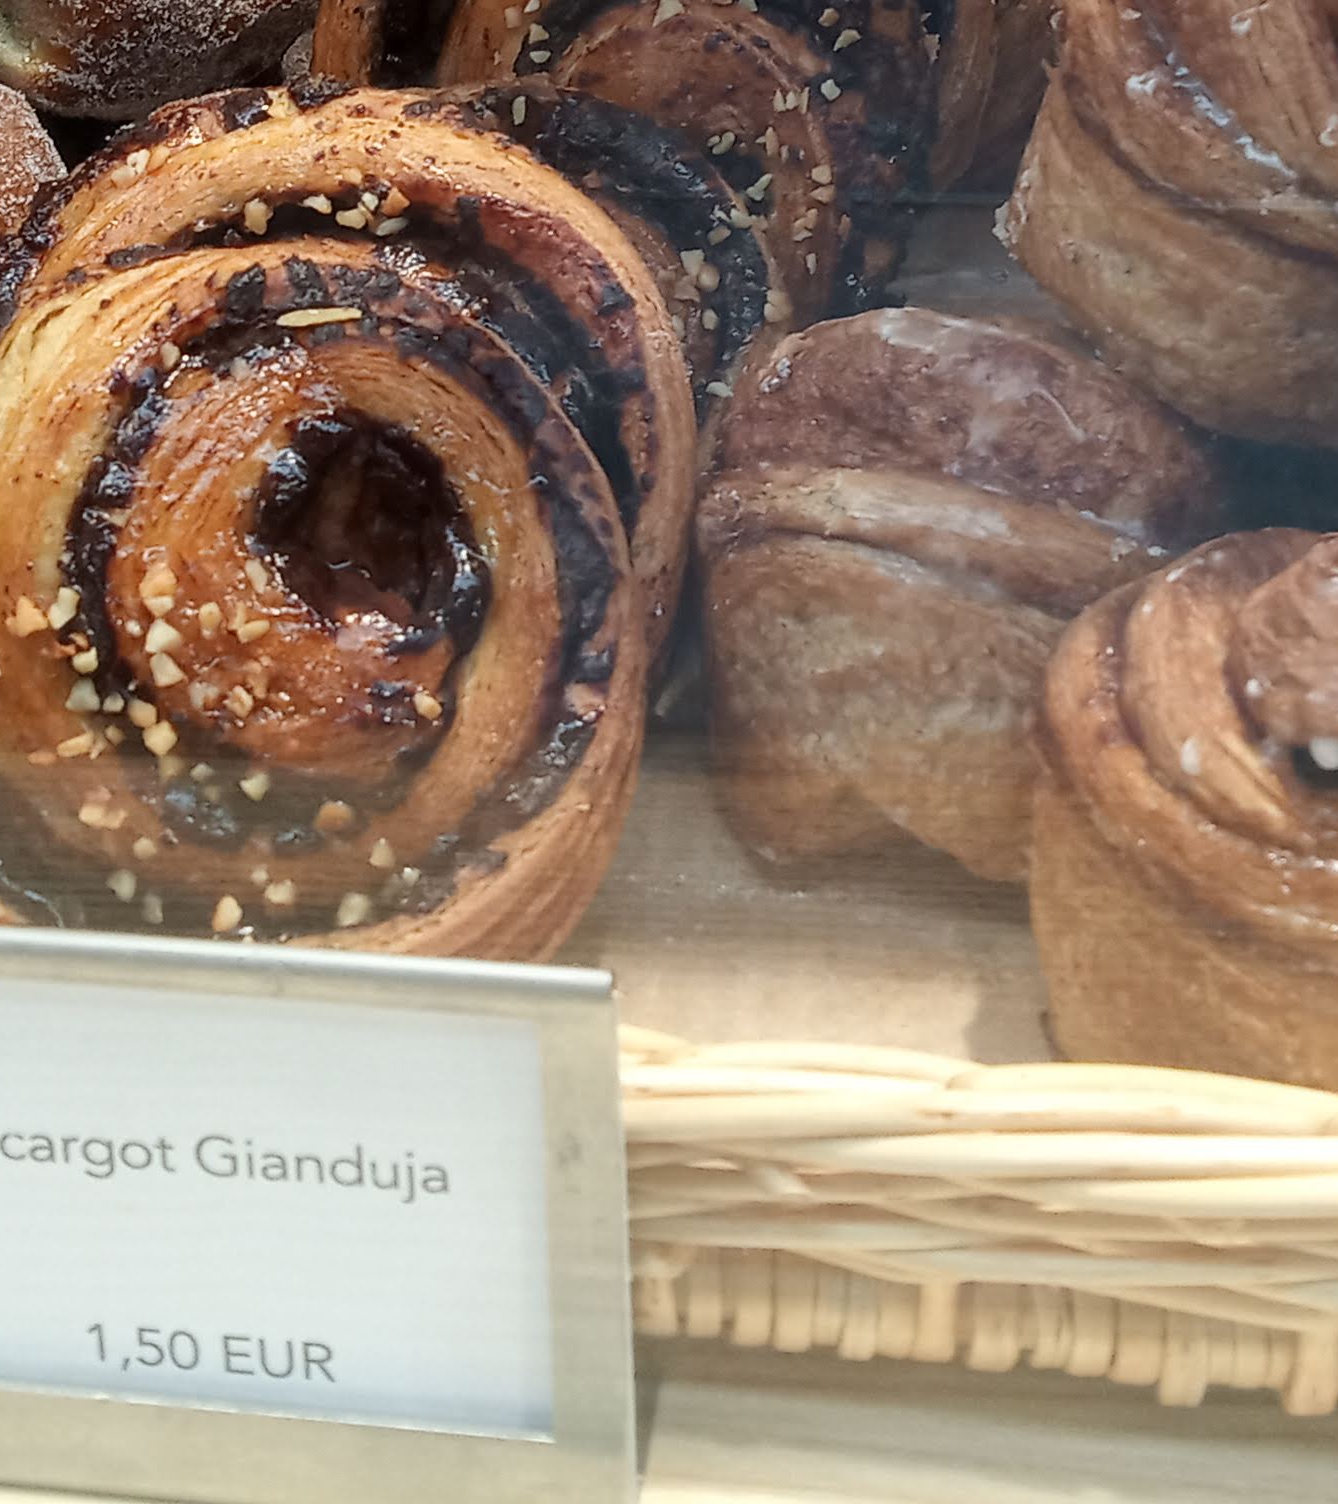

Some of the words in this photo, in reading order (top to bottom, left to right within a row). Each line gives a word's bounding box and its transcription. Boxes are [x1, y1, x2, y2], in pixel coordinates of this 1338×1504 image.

[194, 1133, 451, 1205] Gianduja
[86, 1322, 202, 1373] 1,50
[223, 1334, 338, 1384] EUR
